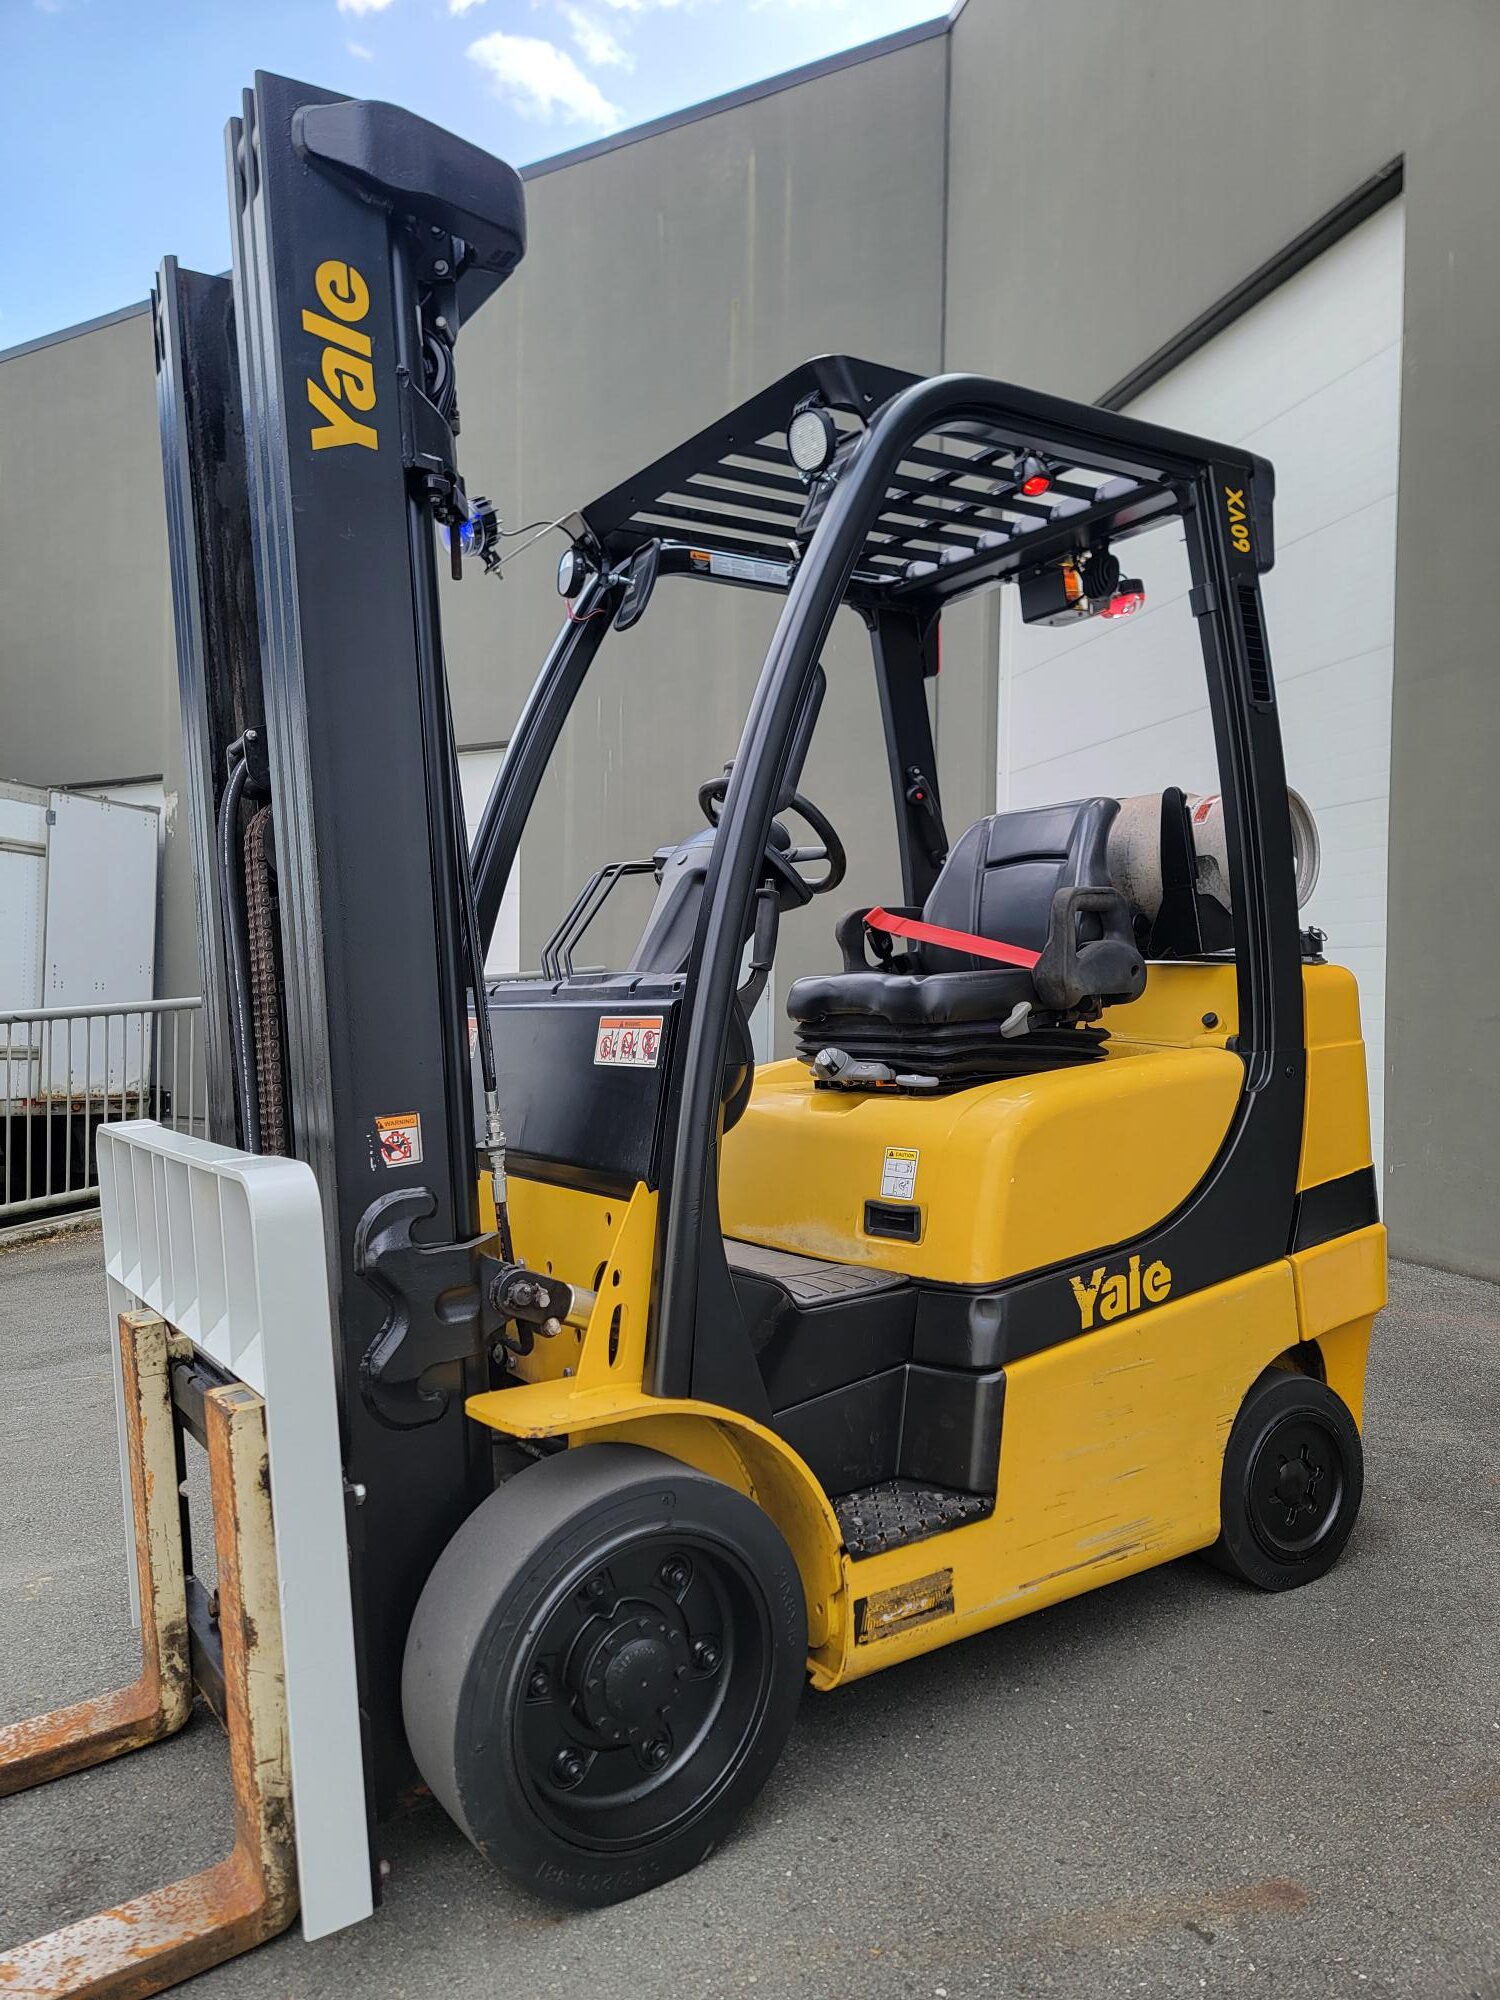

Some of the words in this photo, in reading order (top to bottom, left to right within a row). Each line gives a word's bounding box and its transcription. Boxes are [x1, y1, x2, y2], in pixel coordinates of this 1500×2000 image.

[302, 260, 379, 450] Yale
[1224, 486, 1251, 553] 60VX
[384, 1118, 415, 1127] WARNING
[1069, 1255, 1172, 1330] Yale
